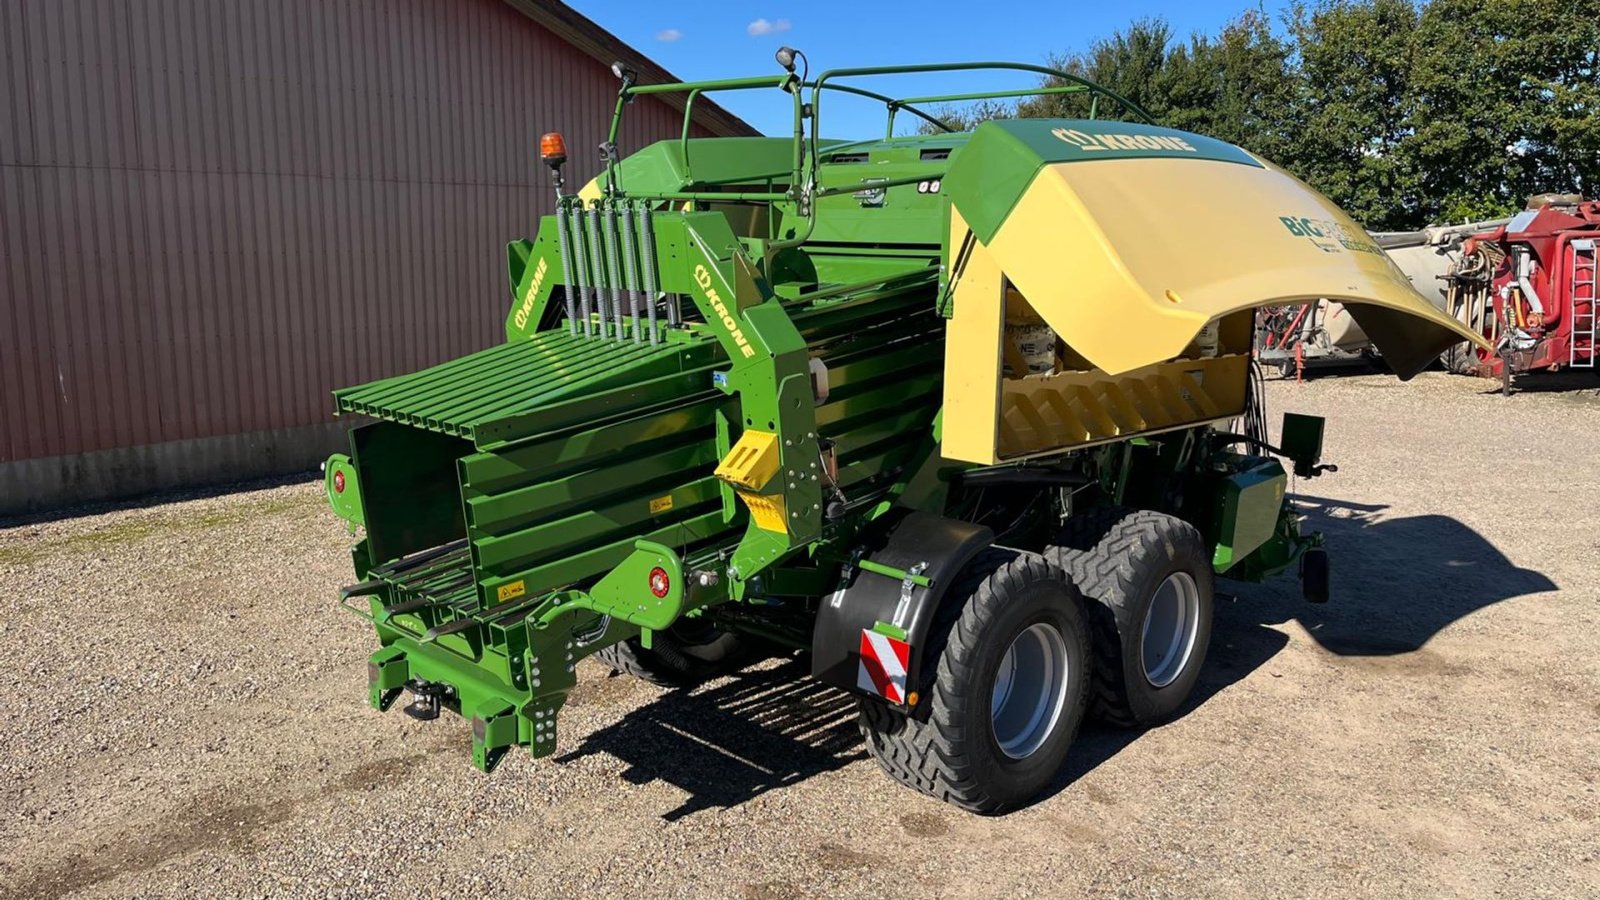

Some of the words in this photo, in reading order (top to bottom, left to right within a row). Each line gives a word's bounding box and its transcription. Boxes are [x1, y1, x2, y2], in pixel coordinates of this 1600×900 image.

[1094, 134, 1197, 152] KRONE
[522, 256, 548, 317] KRONE
[705, 288, 755, 358] KRONE
